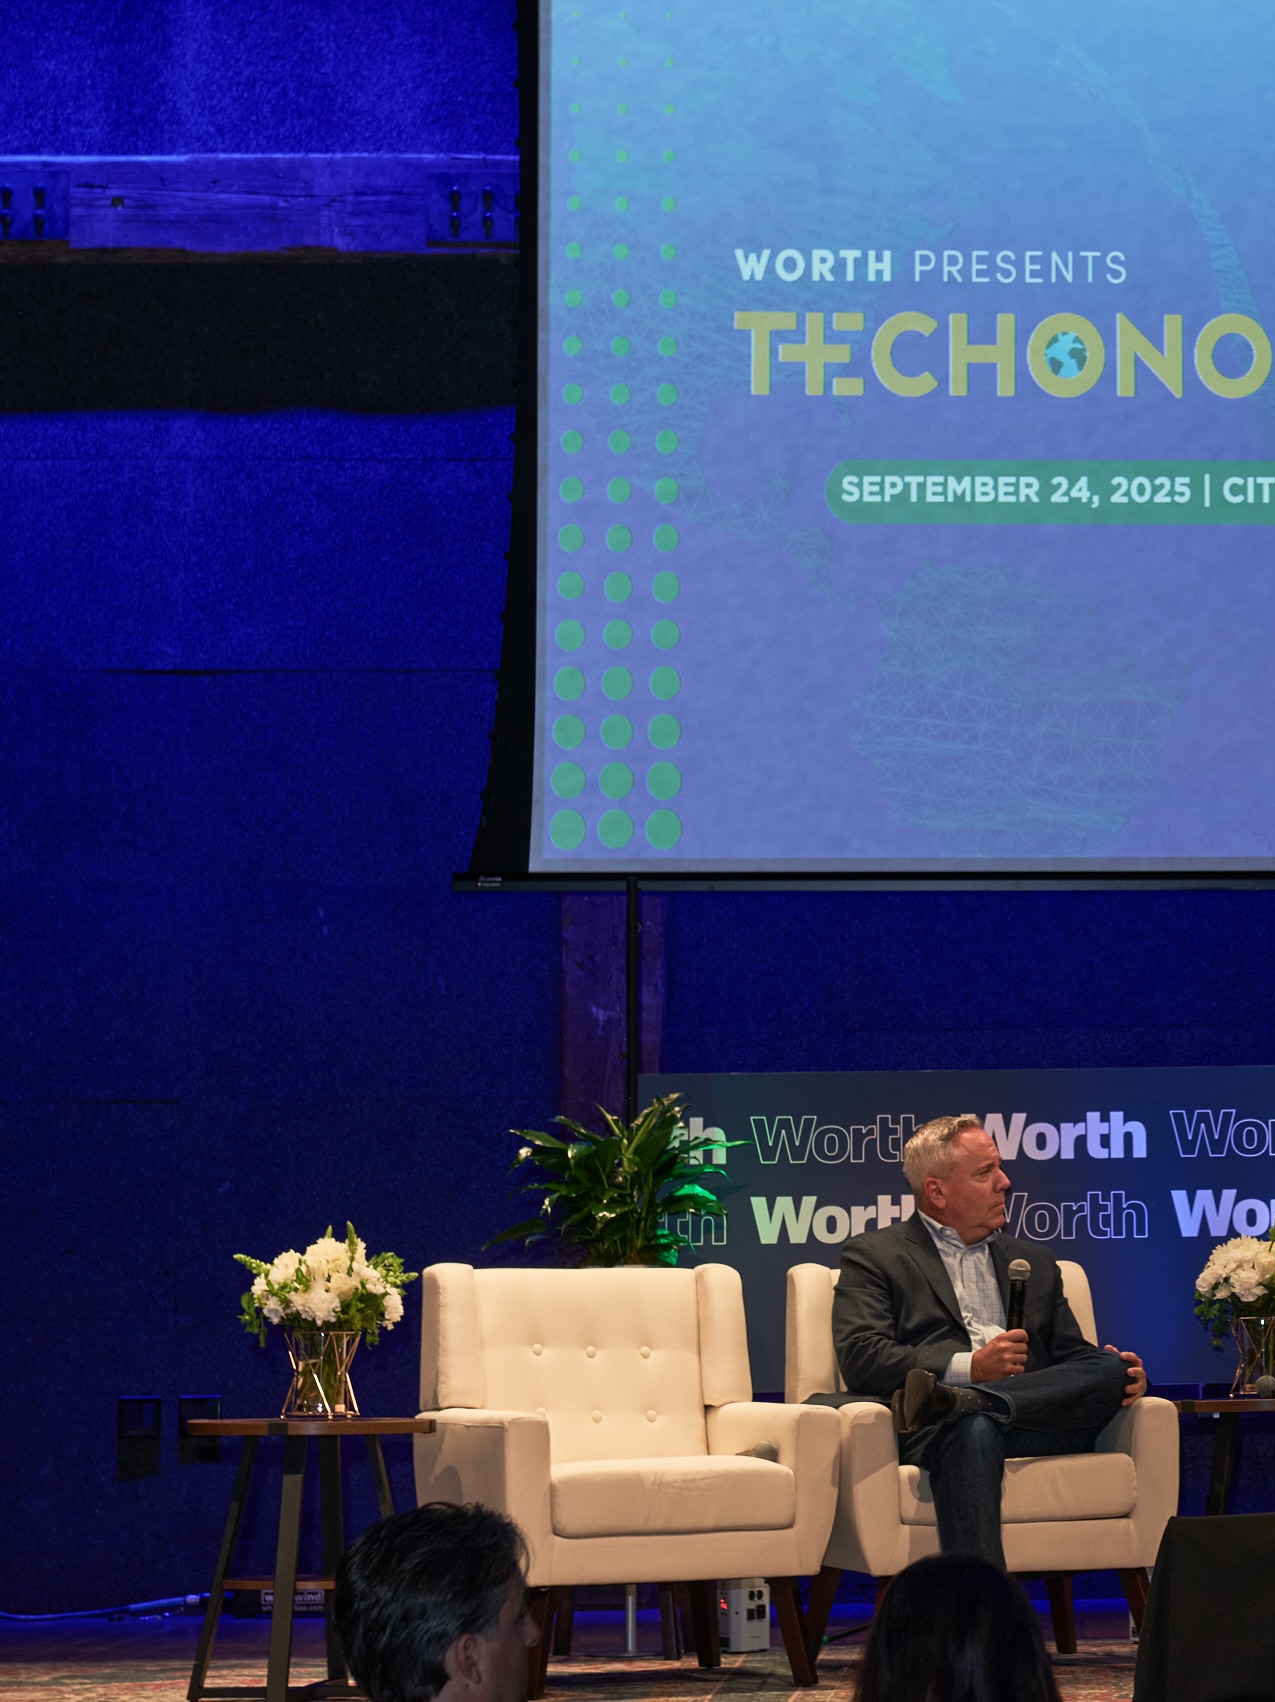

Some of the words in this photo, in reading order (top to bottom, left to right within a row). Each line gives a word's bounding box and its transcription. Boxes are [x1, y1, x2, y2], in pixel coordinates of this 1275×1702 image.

[735, 249, 892, 282] WORTH
[914, 250, 1128, 284] PRESENTS
[841, 475, 1039, 503] SEPTEMBER
[1050, 477, 1100, 508] 24,
[1111, 477, 1191, 504] 2025
